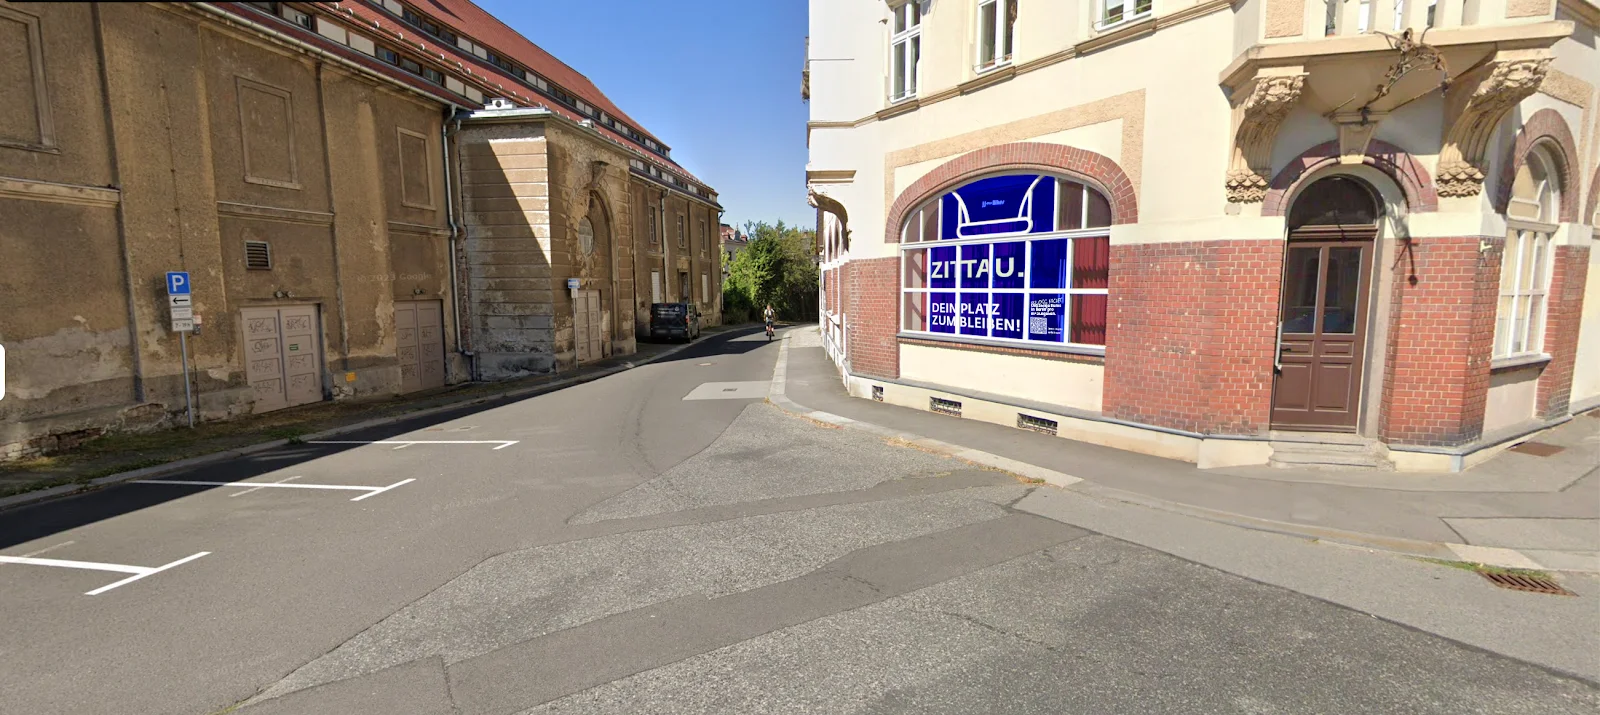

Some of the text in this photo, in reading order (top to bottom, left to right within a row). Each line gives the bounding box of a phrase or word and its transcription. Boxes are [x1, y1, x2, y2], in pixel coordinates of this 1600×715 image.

[931, 257, 1024, 279] ZITTAU.
[172, 275, 185, 292] P
[932, 302, 1000, 316] DEIN PLATZ
[932, 315, 1021, 332] ZUM BLEIBEN!
